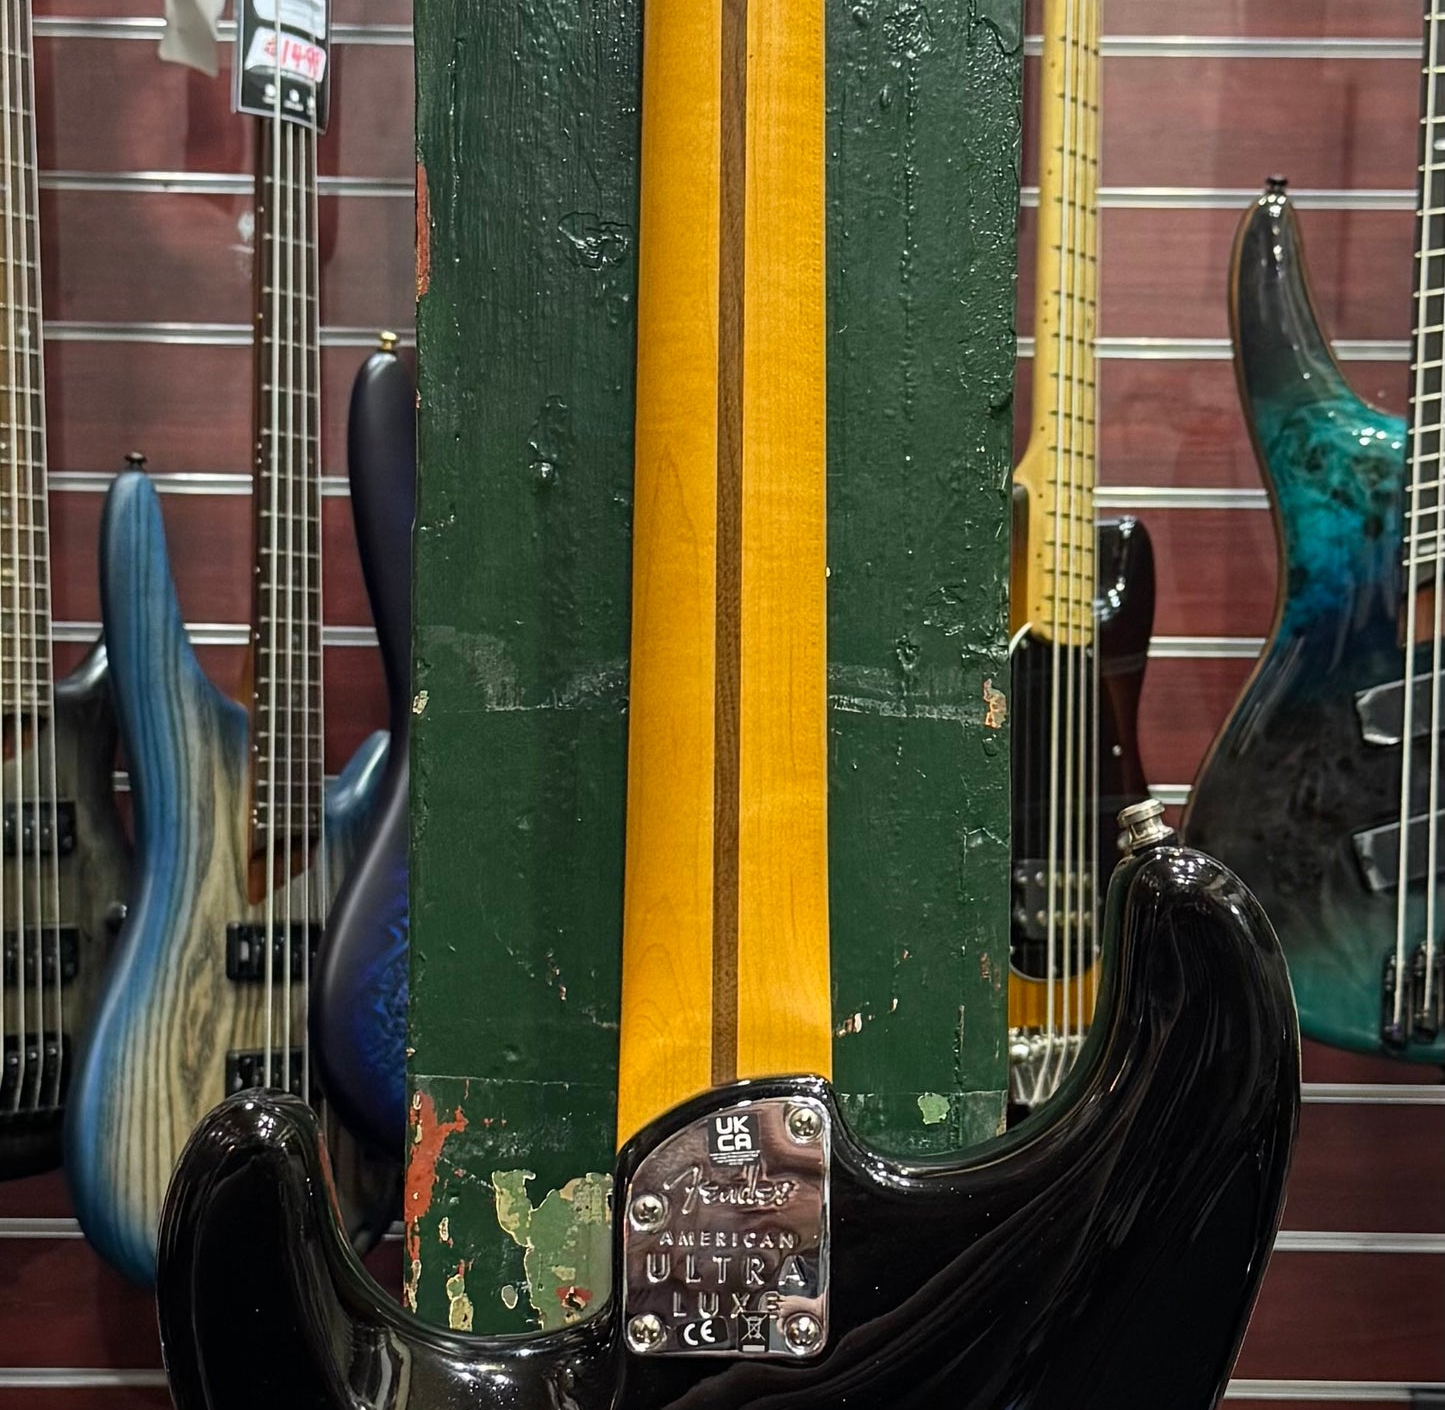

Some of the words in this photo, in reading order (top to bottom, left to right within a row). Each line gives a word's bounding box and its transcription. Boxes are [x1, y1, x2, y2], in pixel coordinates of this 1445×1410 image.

[716, 1116, 749, 1134] UK
[717, 1134, 752, 1151] CA
[663, 1162, 797, 1215] Fender
[659, 1230, 795, 1249] AMERICAN
[647, 1253, 808, 1285] ULTRA
[672, 1291, 780, 1319] LUXE
[683, 1320, 716, 1346] CE
